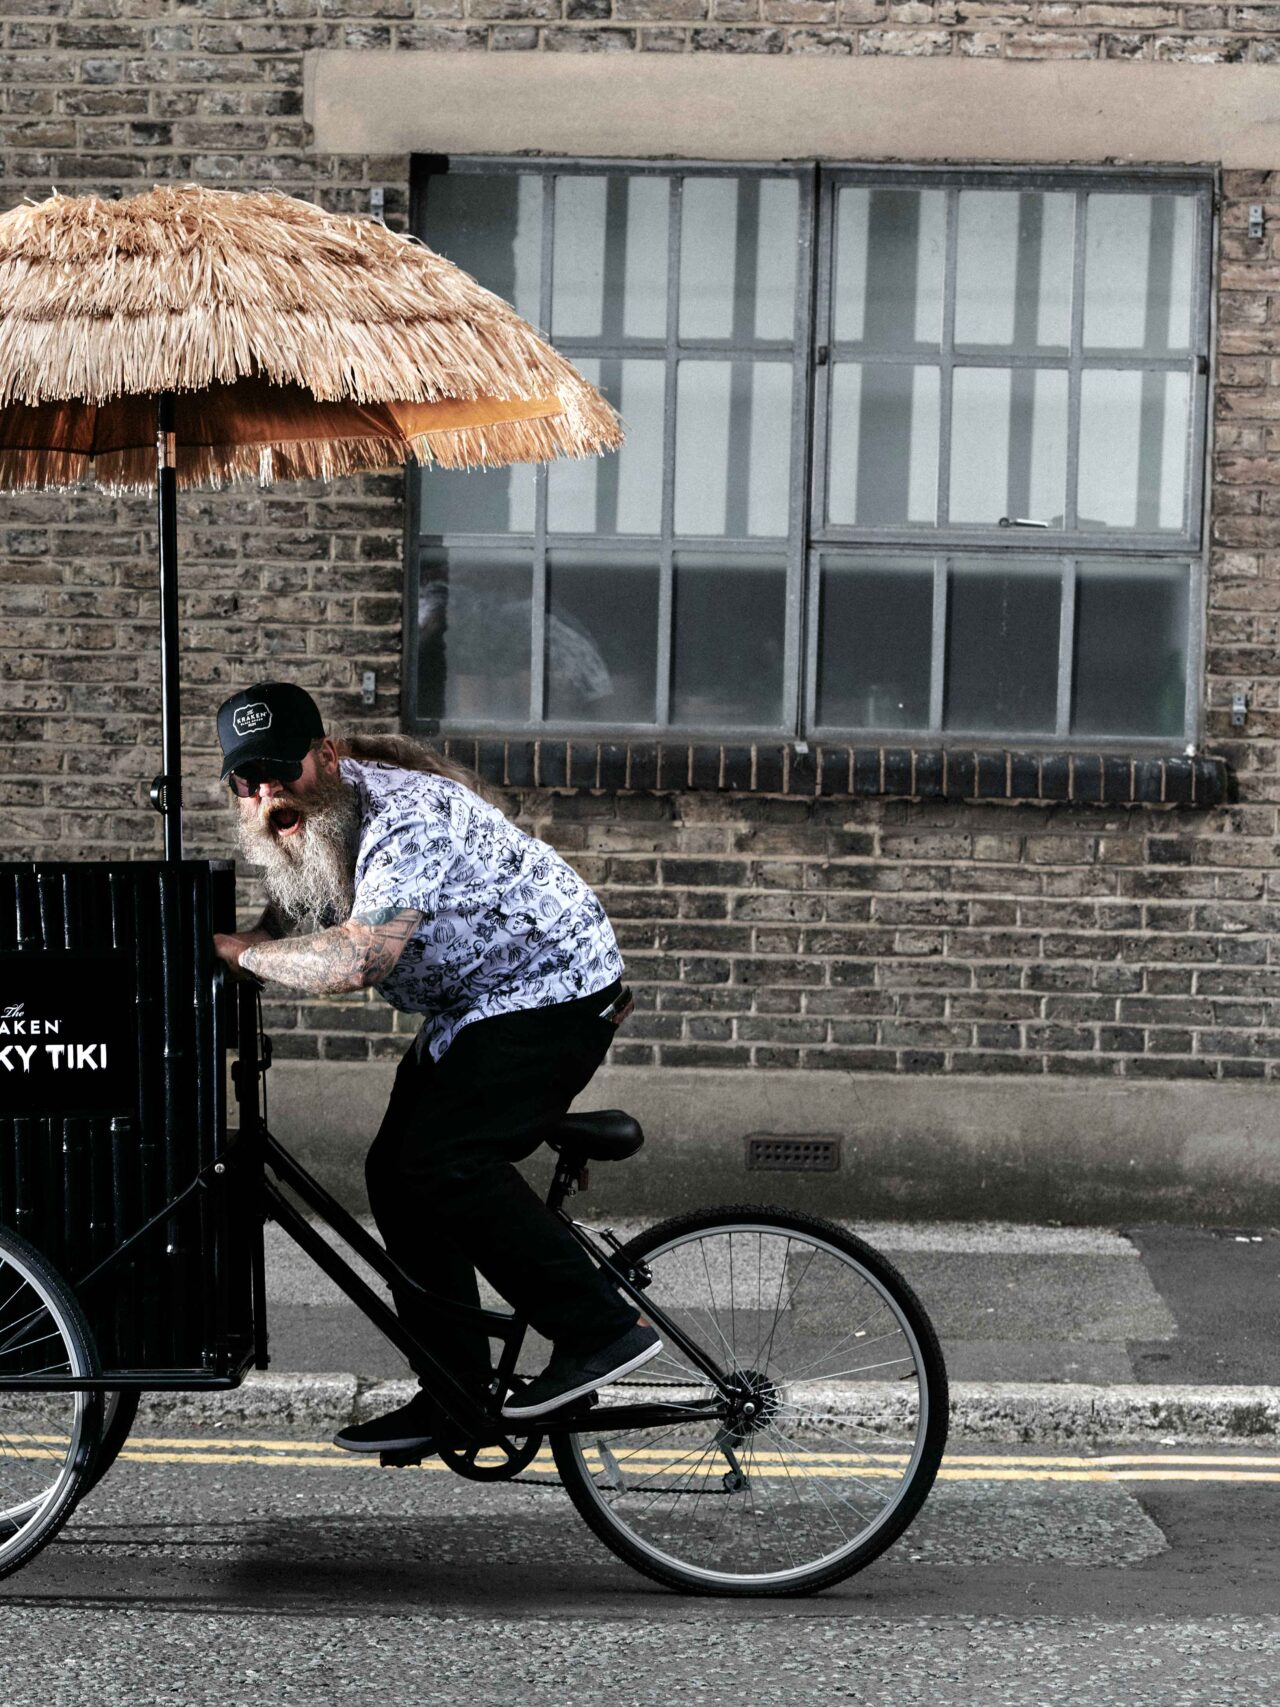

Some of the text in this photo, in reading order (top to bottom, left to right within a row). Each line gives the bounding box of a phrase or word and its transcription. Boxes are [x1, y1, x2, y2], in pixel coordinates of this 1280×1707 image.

[237, 712, 266, 724] KRAKEN
[0, 1003, 24, 1018] The
[45, 1044, 107, 1070] TIKI
